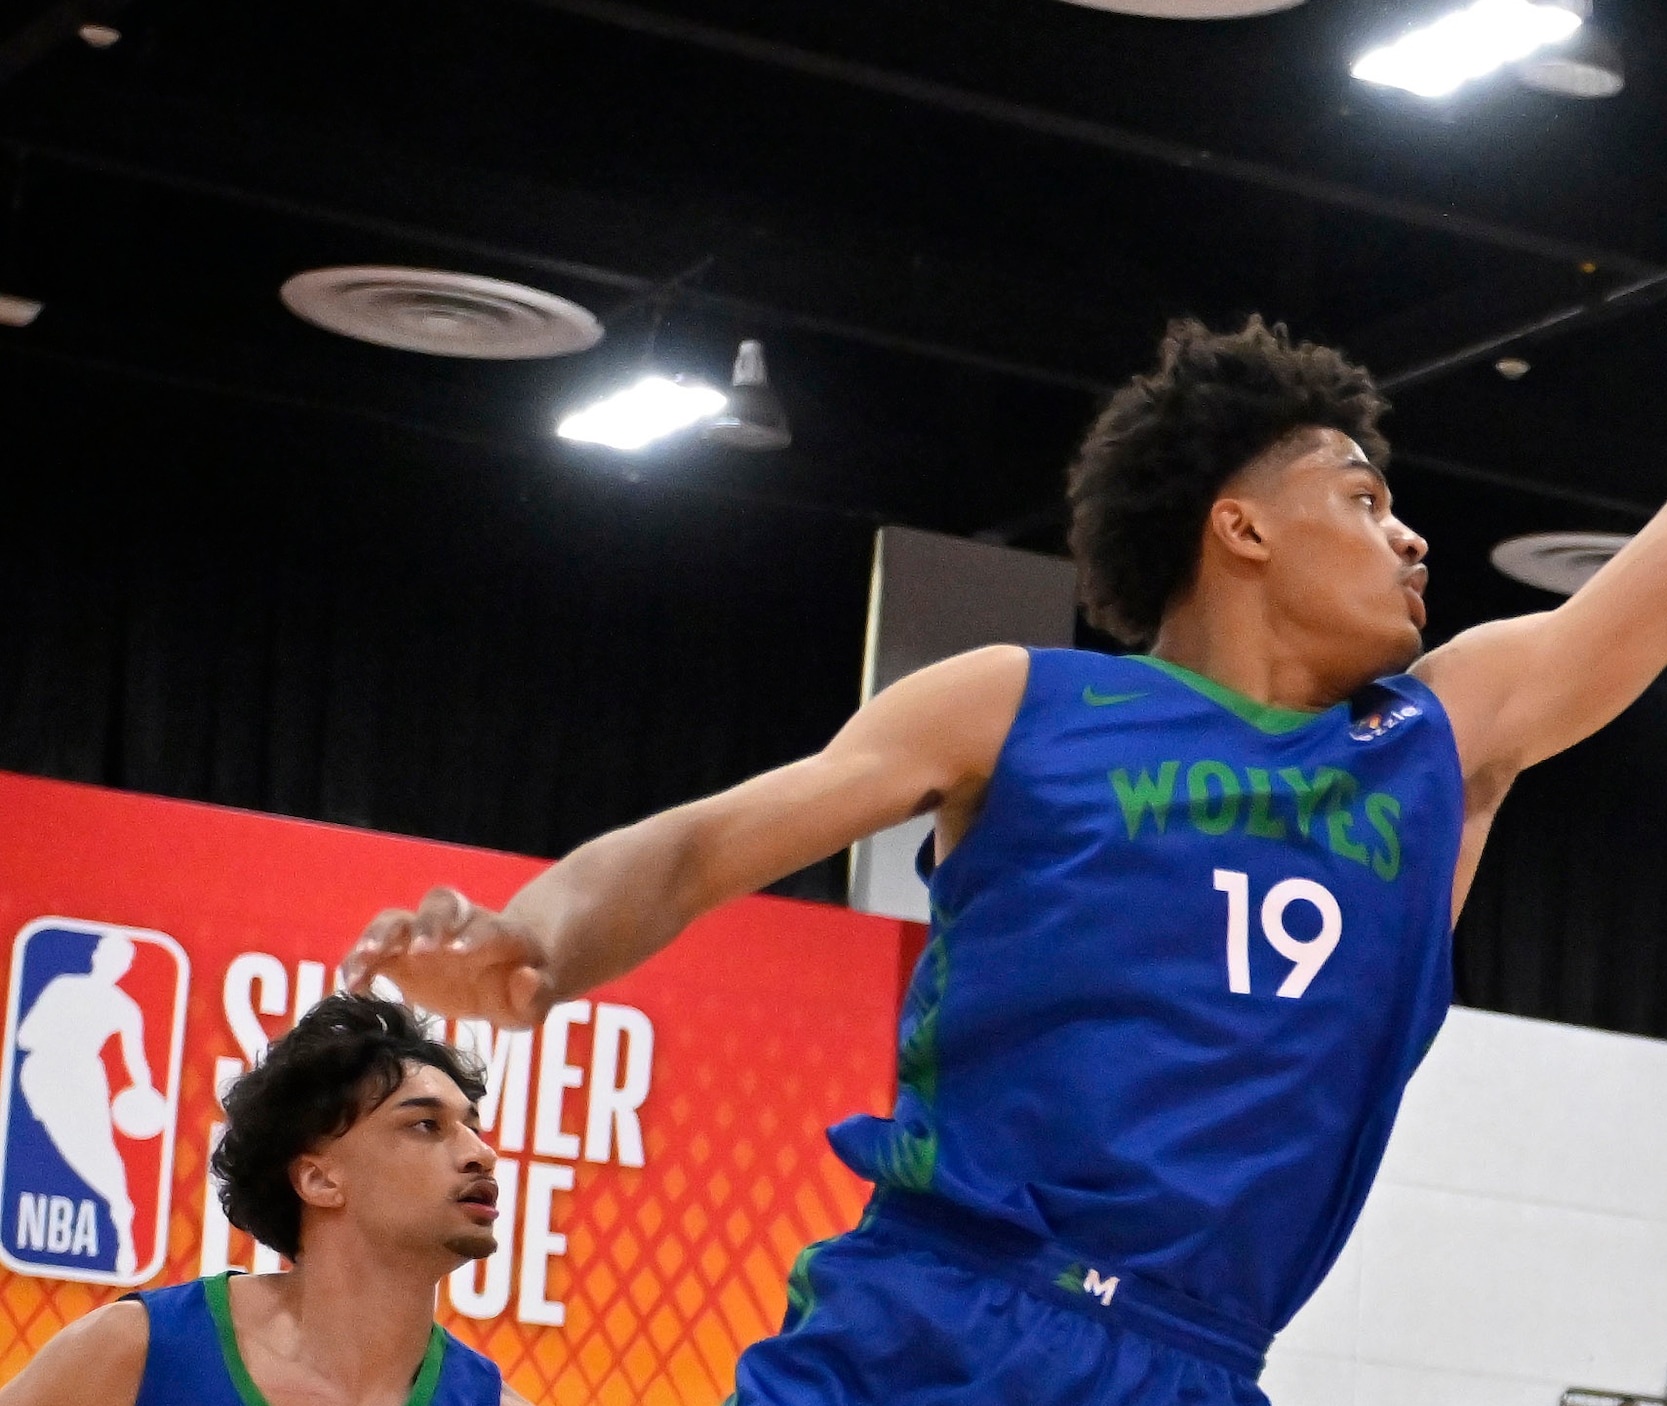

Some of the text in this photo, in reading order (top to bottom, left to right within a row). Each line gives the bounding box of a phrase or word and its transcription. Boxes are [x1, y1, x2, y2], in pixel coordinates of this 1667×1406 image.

[1107, 760, 1401, 883] WOLVES
[1213, 867, 1343, 999] 19
[15, 1191, 100, 1257] NBA
